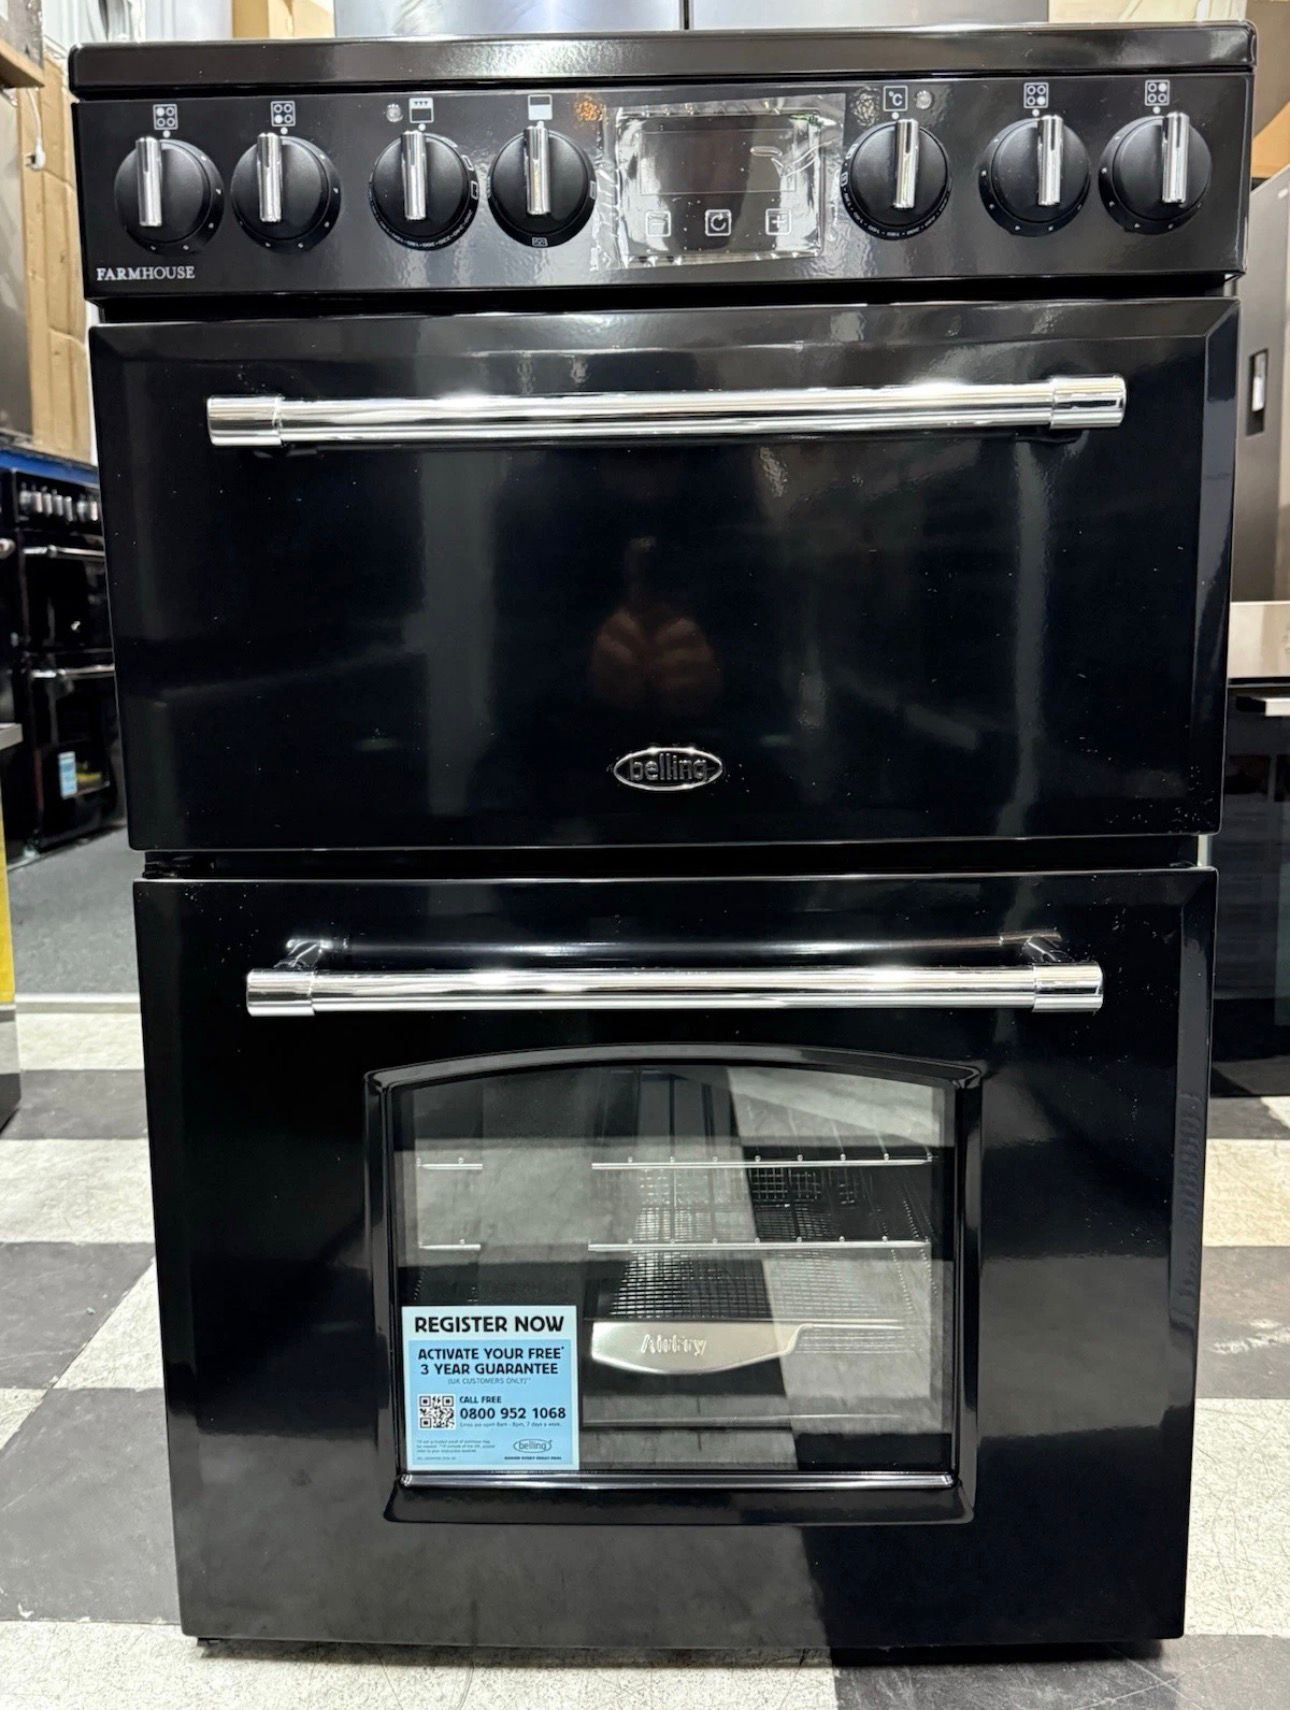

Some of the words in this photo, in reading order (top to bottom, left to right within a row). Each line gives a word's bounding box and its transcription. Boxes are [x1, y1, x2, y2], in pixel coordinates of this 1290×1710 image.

[96, 265, 195, 281] FARMHOUSE
[628, 752, 710, 782] belling
[414, 1316, 508, 1333] REGISTER
[514, 1316, 565, 1332] NOW
[418, 1348, 479, 1360] ACTIVATE
[482, 1348, 524, 1360] YOUR
[420, 1364, 429, 1375] 3
[434, 1363, 470, 1375] YEAR
[475, 1363, 559, 1375] GUARANTEE
[459, 1396, 479, 1404] CALL
[481, 1396, 502, 1404] FREE
[459, 1407, 496, 1420] 0800
[500, 1407, 527, 1420] 952
[532, 1407, 567, 1420] 1068
[518, 1440, 547, 1452] belling
